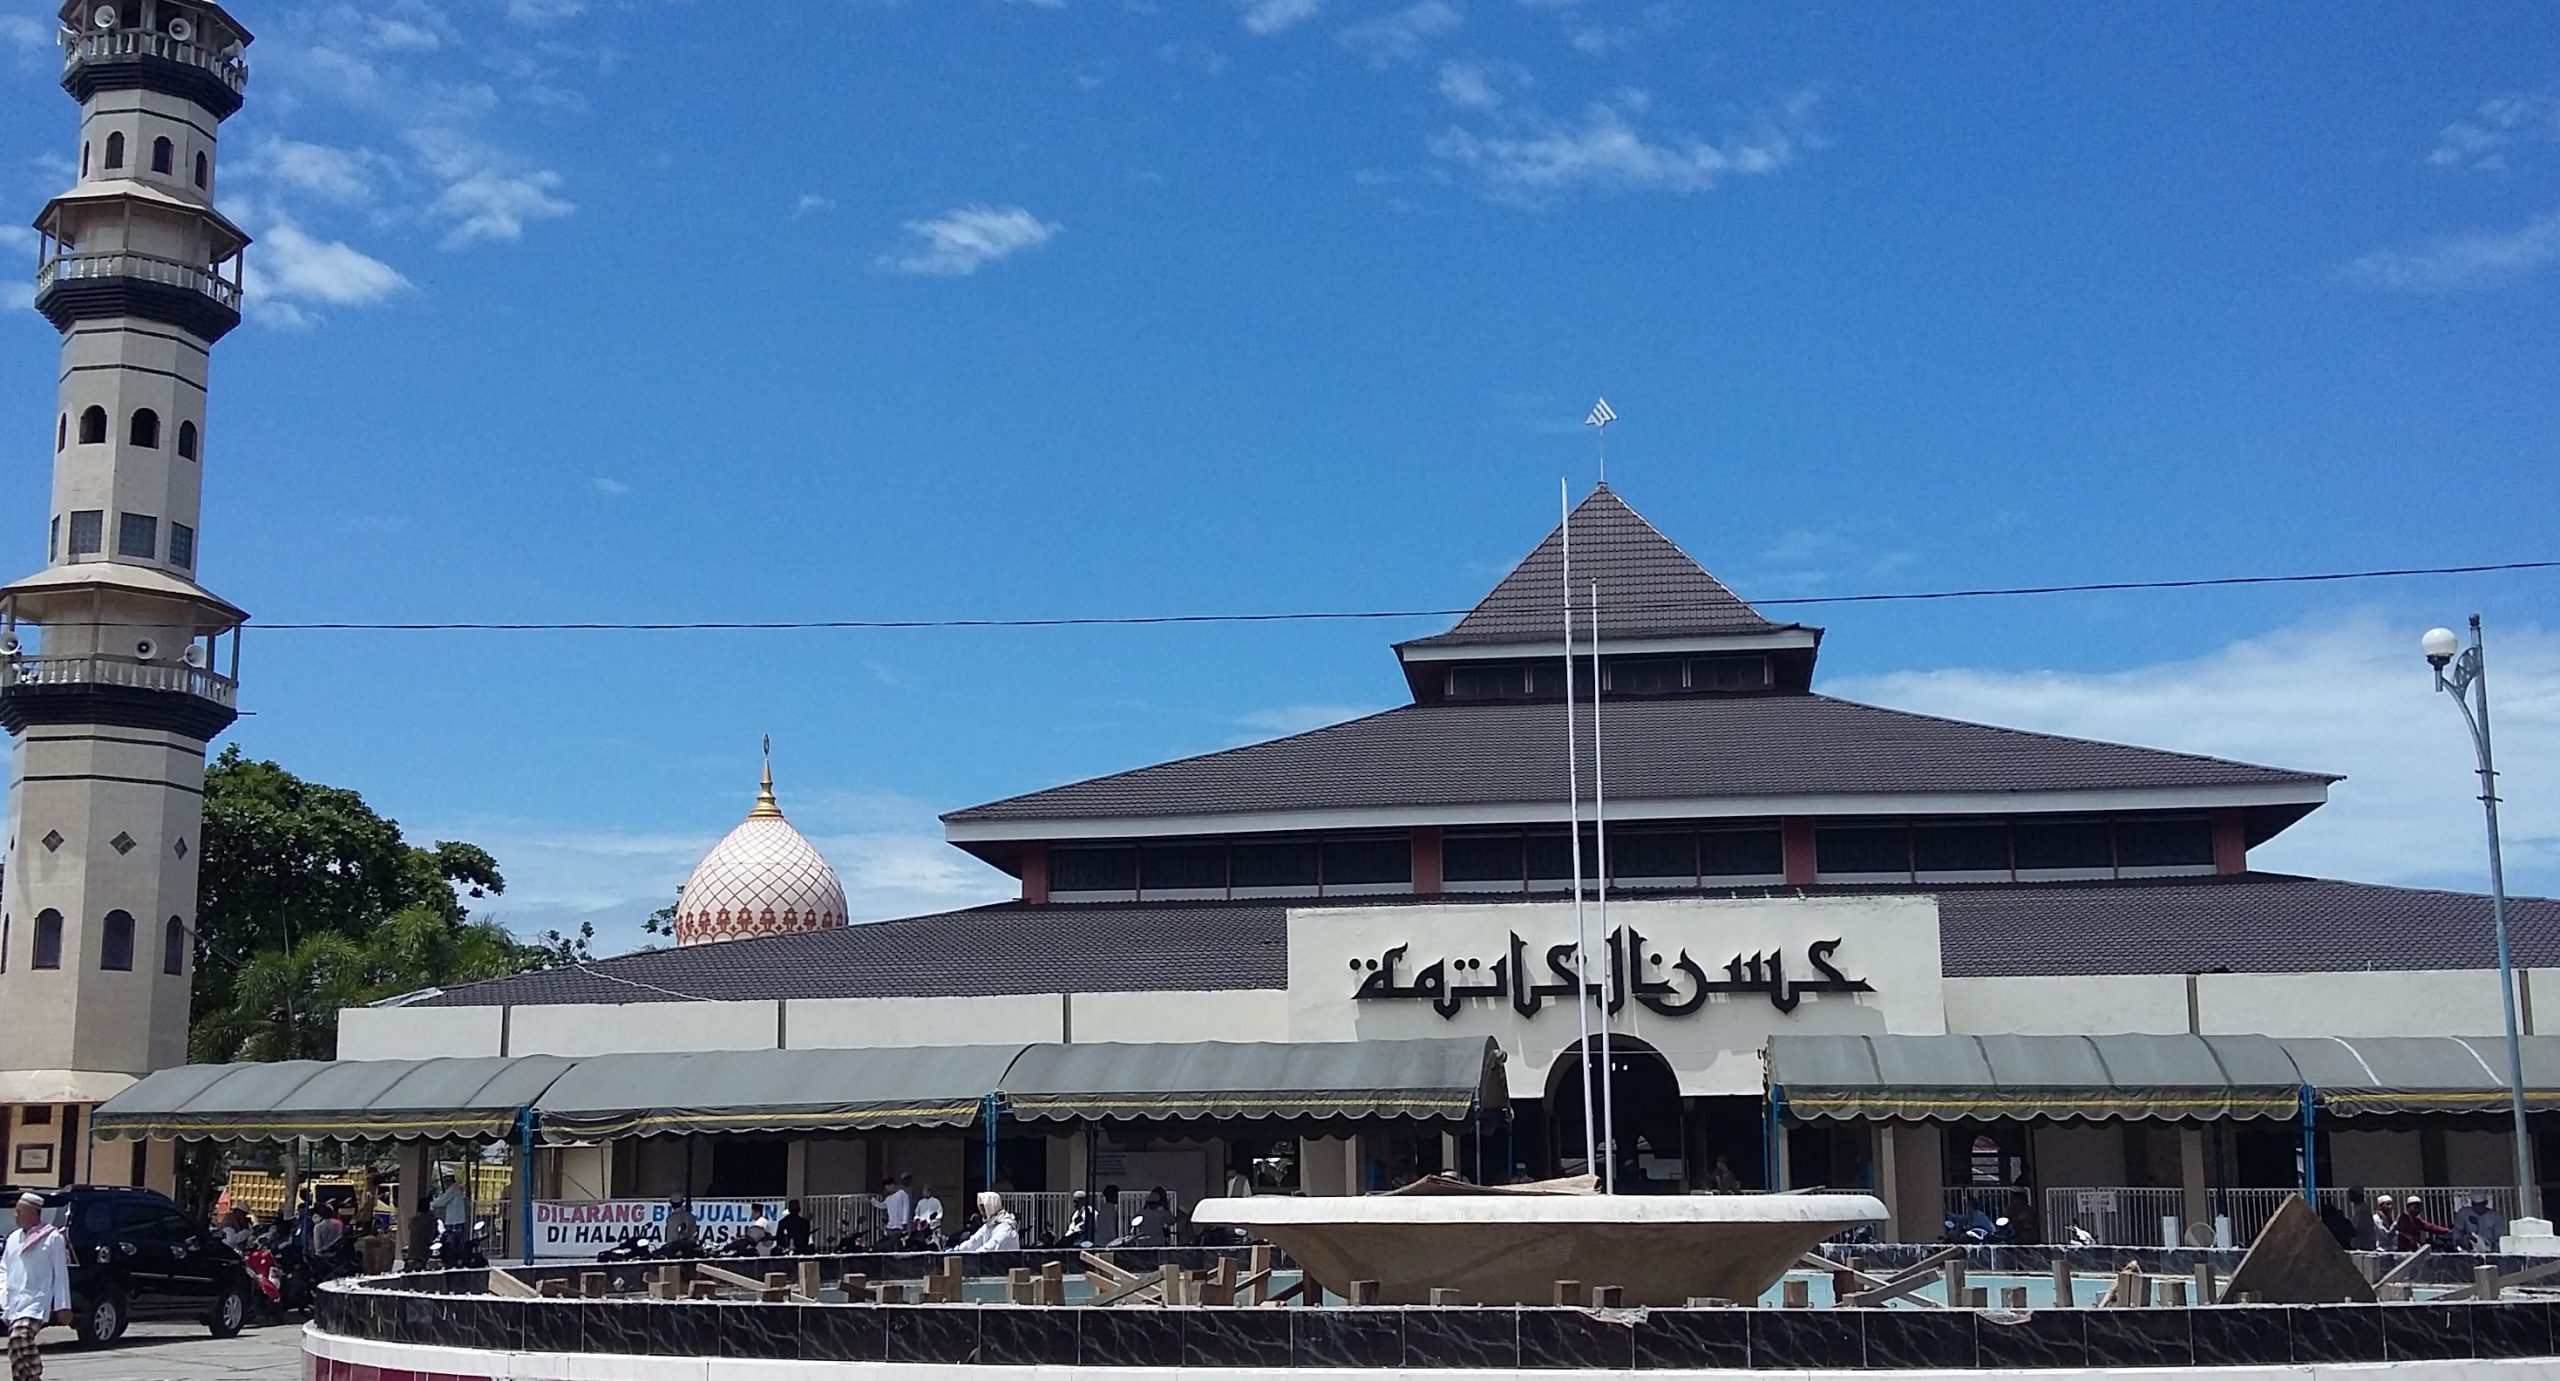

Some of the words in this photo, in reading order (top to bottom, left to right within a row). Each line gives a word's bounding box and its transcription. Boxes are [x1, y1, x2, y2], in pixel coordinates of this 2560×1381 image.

[537, 1203, 645, 1223] DILARANG
[653, 1203, 778, 1223] BJUALN
[547, 1225, 568, 1243] DI
[575, 1225, 668, 1243] HALAMA
